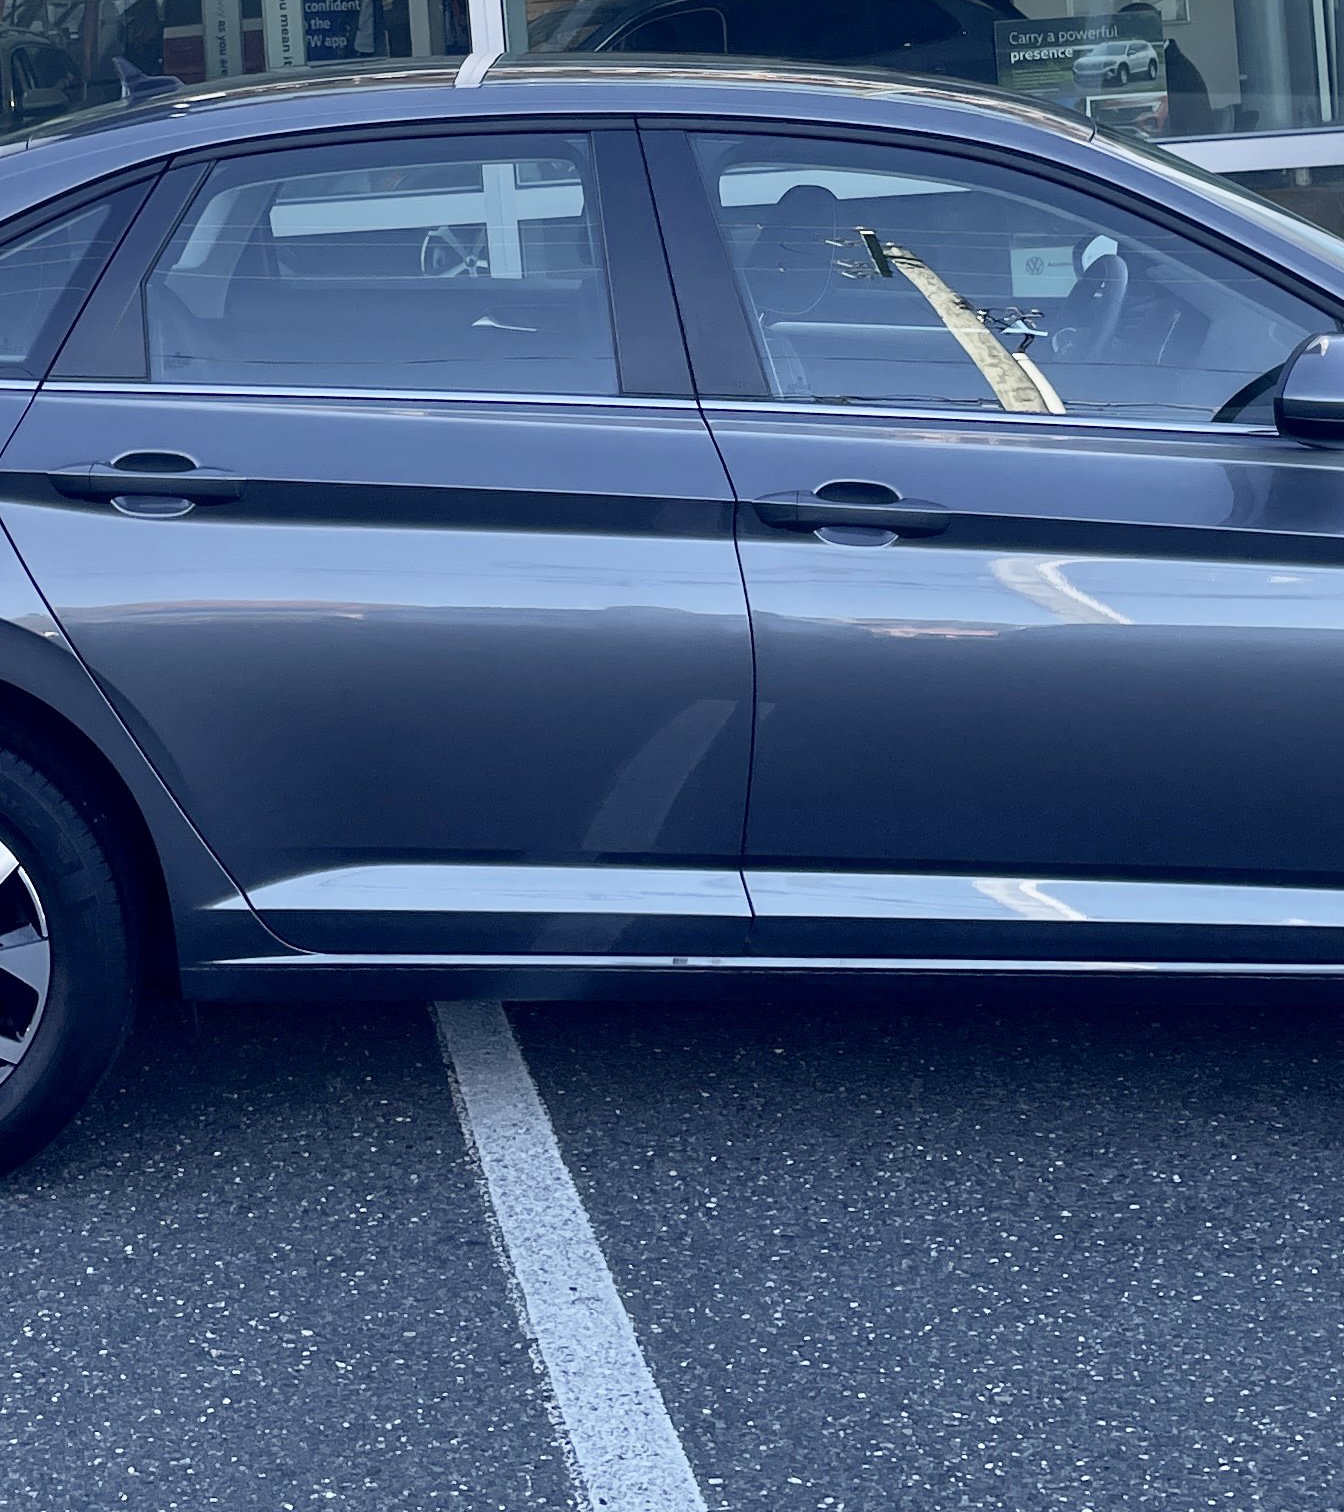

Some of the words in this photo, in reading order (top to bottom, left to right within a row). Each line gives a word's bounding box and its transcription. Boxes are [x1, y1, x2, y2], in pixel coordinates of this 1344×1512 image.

[305, 0, 360, 12] confident
[218, 20, 227, 33] as
[310, 18, 331, 29] the
[279, 14, 292, 52] mean
[1009, 31, 1044, 47] Carry
[1047, 33, 1055, 42] a
[1059, 25, 1118, 44] powerful
[215, 35, 228, 56] you
[325, 37, 348, 48] app
[1010, 47, 1074, 64] presence
